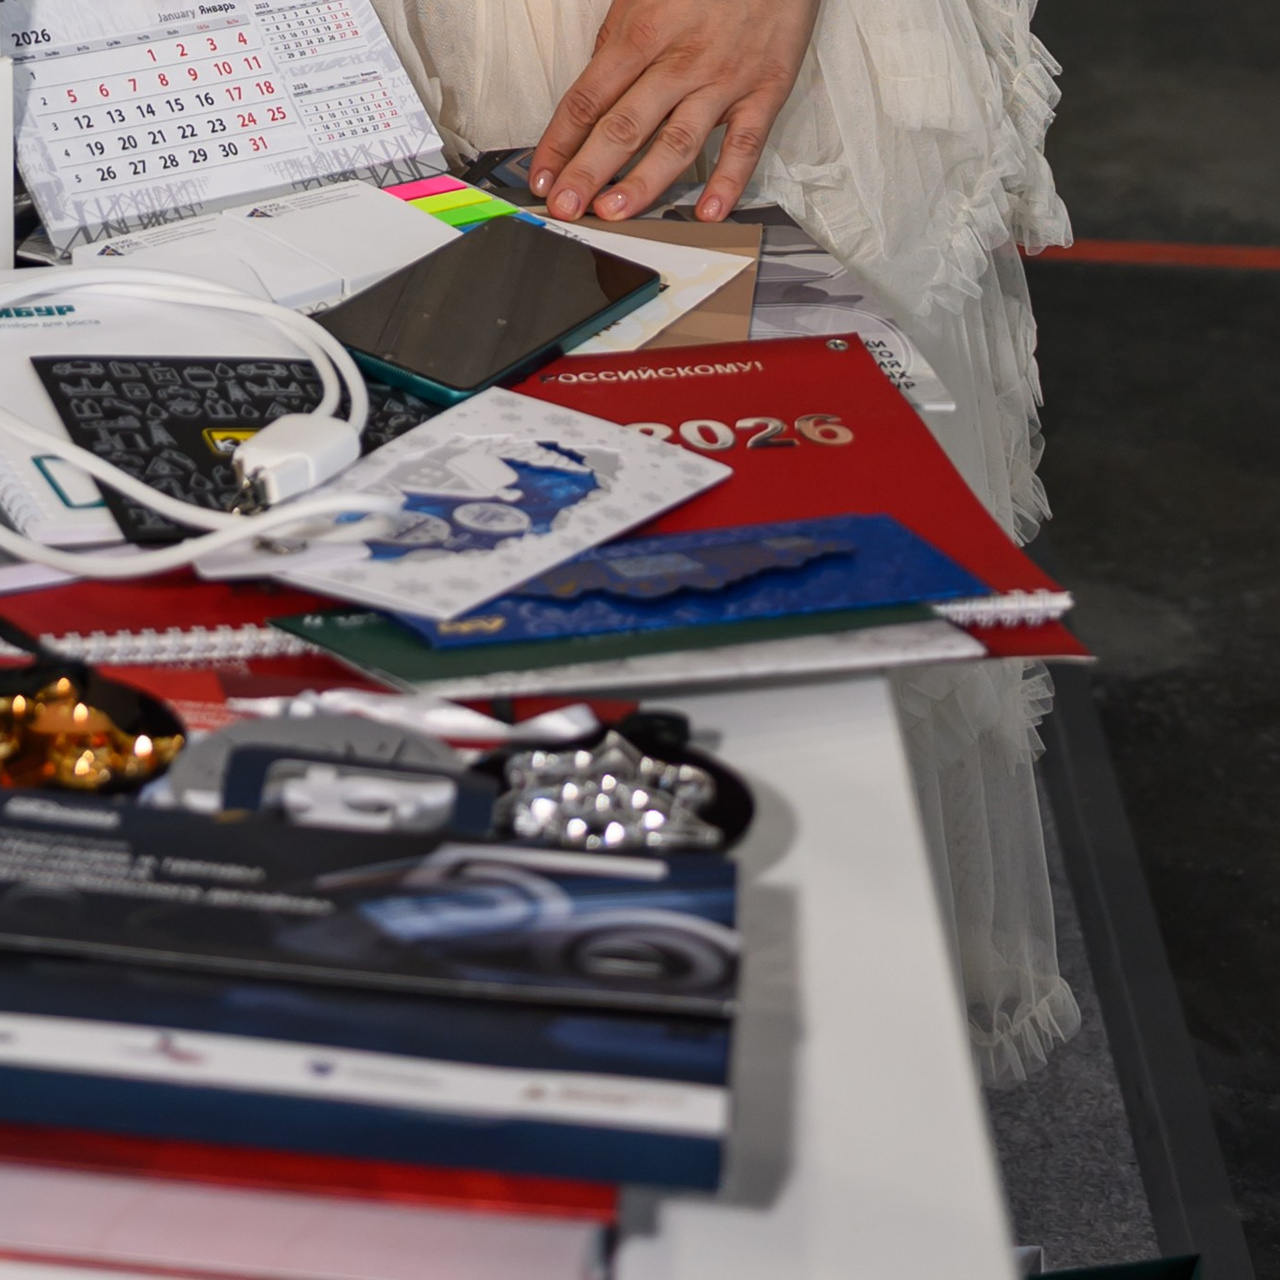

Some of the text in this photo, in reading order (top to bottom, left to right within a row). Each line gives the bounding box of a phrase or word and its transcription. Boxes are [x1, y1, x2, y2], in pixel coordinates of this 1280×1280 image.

[158, 2, 236, 23] January Январь
[11, 28, 51, 47] 2026
[30, 32, 248, 80] 1 1 2 3 4
[41, 56, 262, 106] 2 5 6 7 8 9 10 11
[52, 80, 275, 131] 3 12 13 14 15 16 17 18
[64, 106, 286, 157] 4 19 20 21 22 23 24 25
[75, 136, 268, 183] 5 26 27 28 29 30 31
